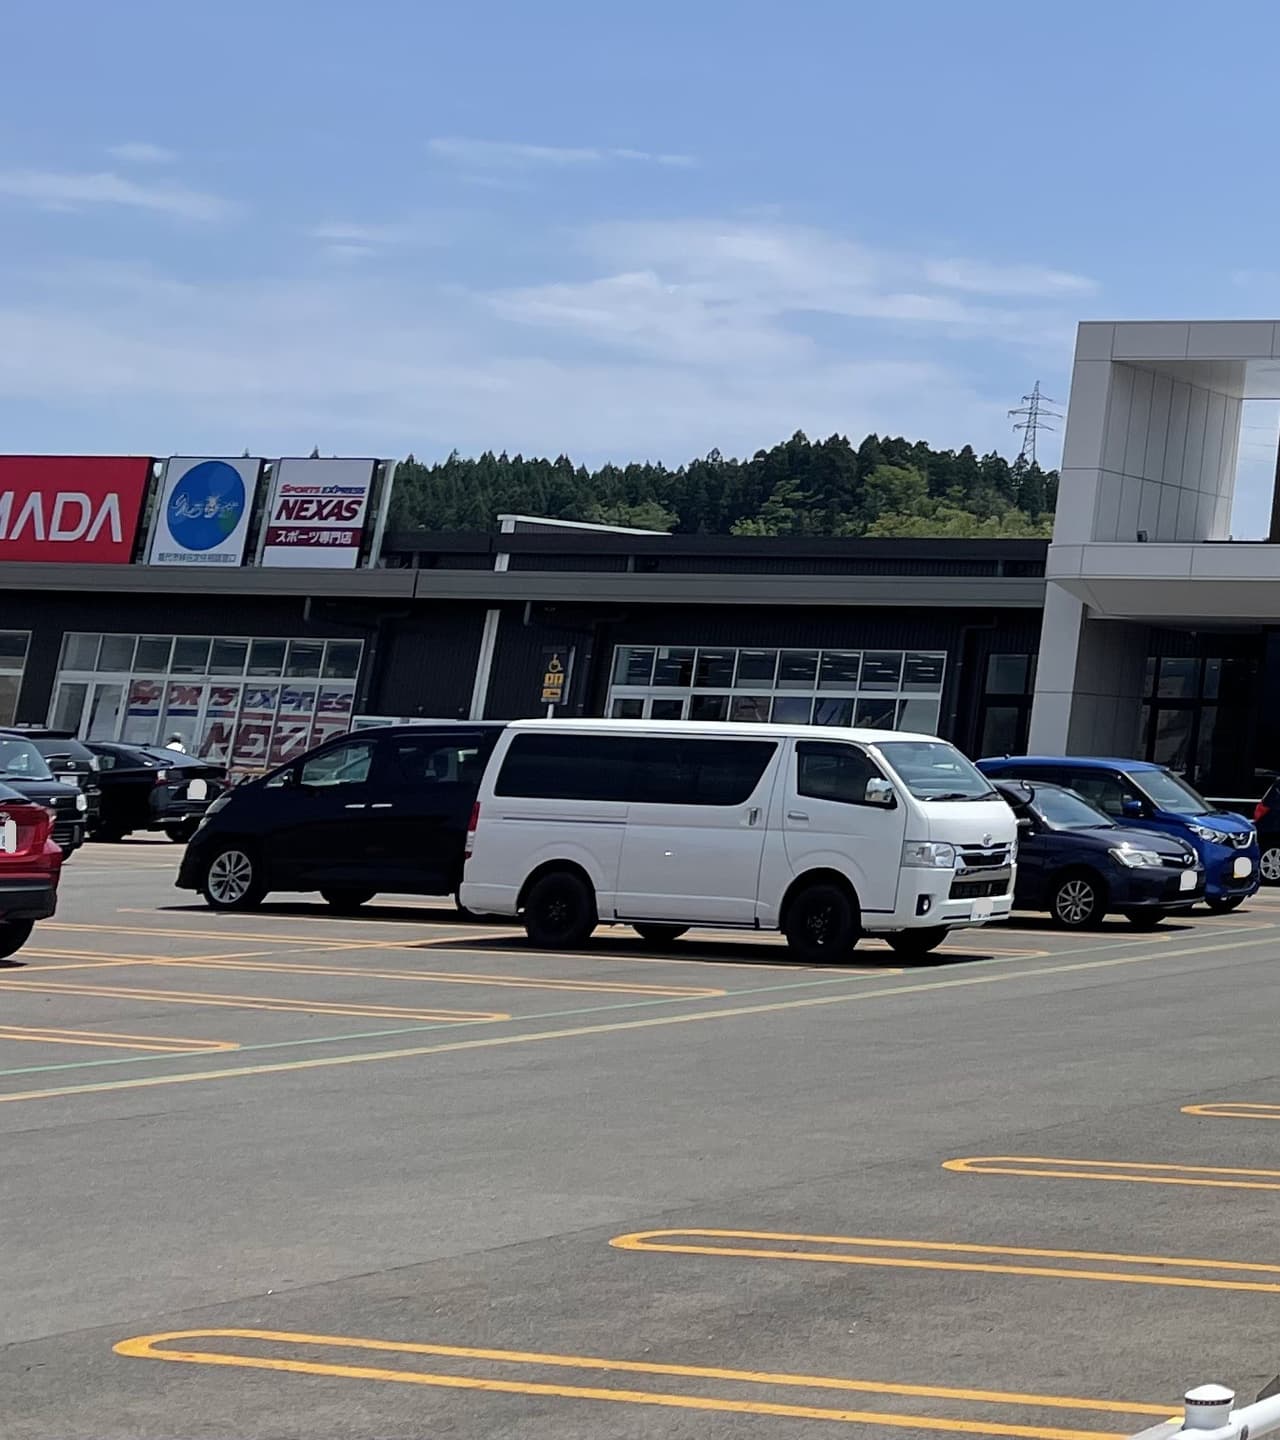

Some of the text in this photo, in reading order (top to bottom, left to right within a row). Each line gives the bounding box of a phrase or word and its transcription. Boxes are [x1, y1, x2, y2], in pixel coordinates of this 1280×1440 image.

[274, 499, 364, 522] NEXAS
[275, 530, 353, 545] スポーツ専門店
